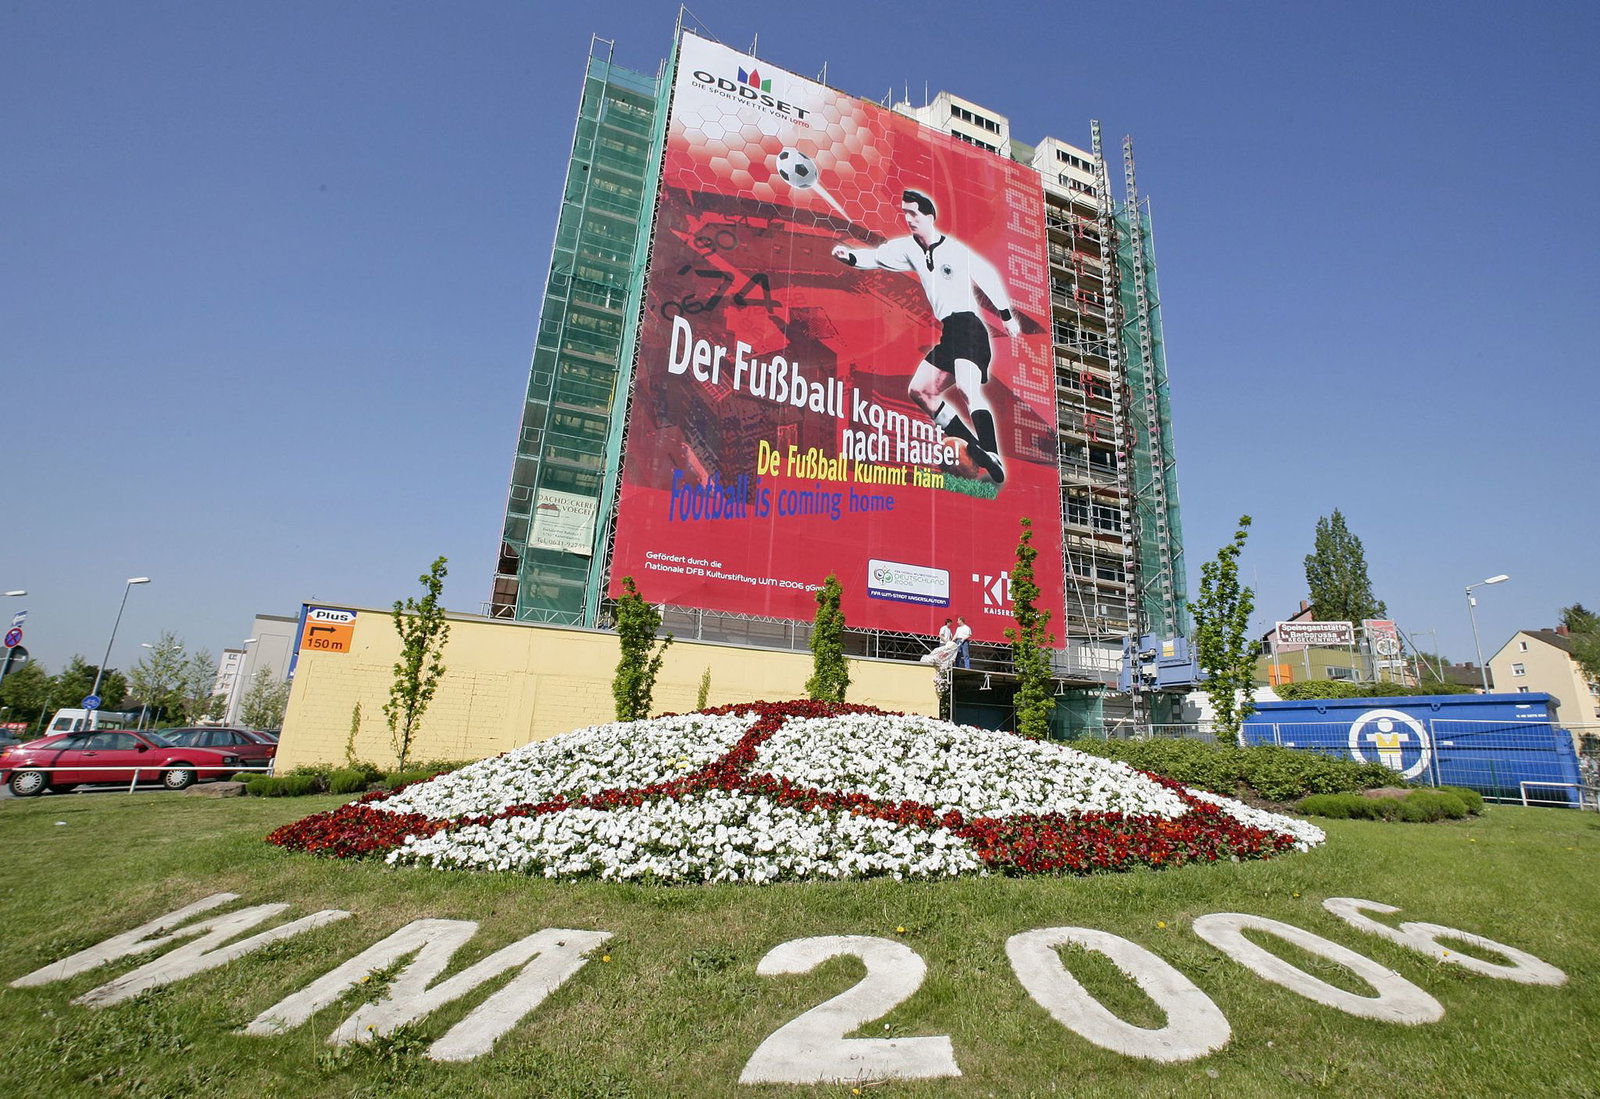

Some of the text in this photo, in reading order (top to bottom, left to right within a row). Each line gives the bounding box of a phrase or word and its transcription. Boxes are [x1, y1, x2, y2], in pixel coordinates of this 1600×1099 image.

[692, 81, 810, 128] DIE SPORTWETTE VON LOTTO
[693, 70, 810, 119] ODDSET
[668, 315, 945, 445] Der Fußball kommt
[757, 440, 944, 489] De Fußball kummt häm
[842, 427, 960, 465] nach Hause!
[668, 469, 895, 522] Football is coming home
[644, 561, 685, 574] Nationale
[686, 567, 705, 576] DFB
[706, 570, 757, 585] Kulturstiftung
[758, 577, 777, 587] WM
[779, 580, 804, 590] 2006
[645, 551, 723, 569] Gefördert durch die
[308, 638, 343, 650] 150 m
[1281, 624, 1347, 632] Speisegaststätte
[738, 896, 1568, 1086] 2006
